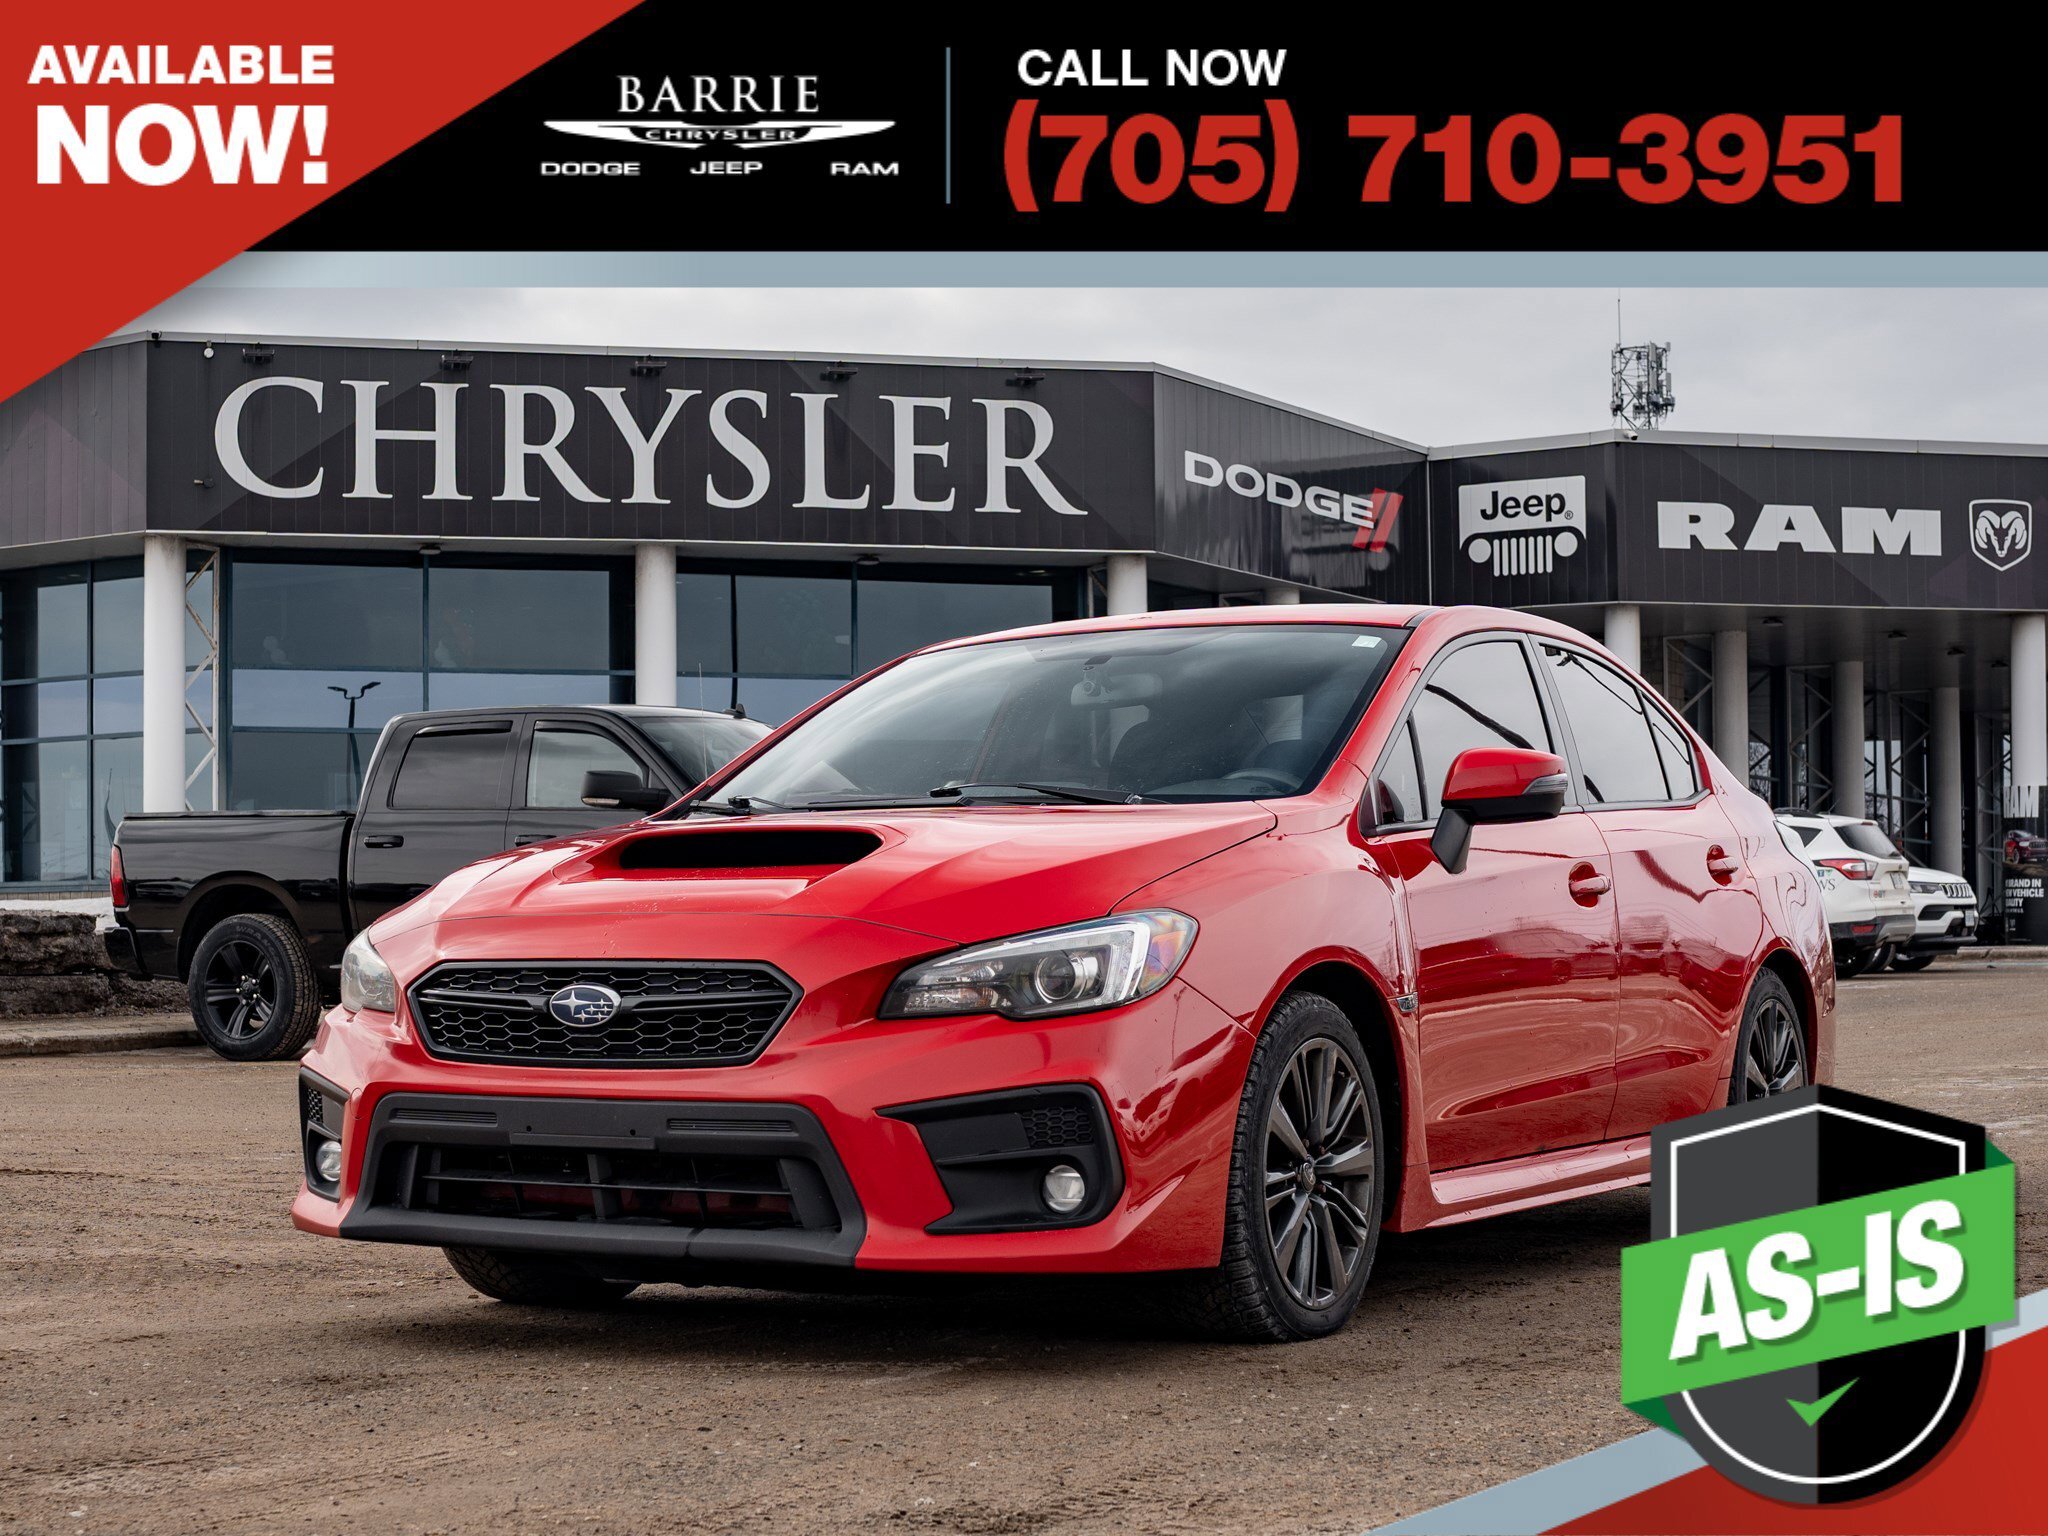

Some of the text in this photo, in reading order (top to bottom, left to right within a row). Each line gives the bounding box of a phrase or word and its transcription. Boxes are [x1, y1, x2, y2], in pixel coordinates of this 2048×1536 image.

[212, 376, 1088, 516] CHRYSLER
[1184, 450, 1375, 529] DODGE
[1480, 490, 1566, 523] Jeep
[1657, 501, 1942, 556] RAM
